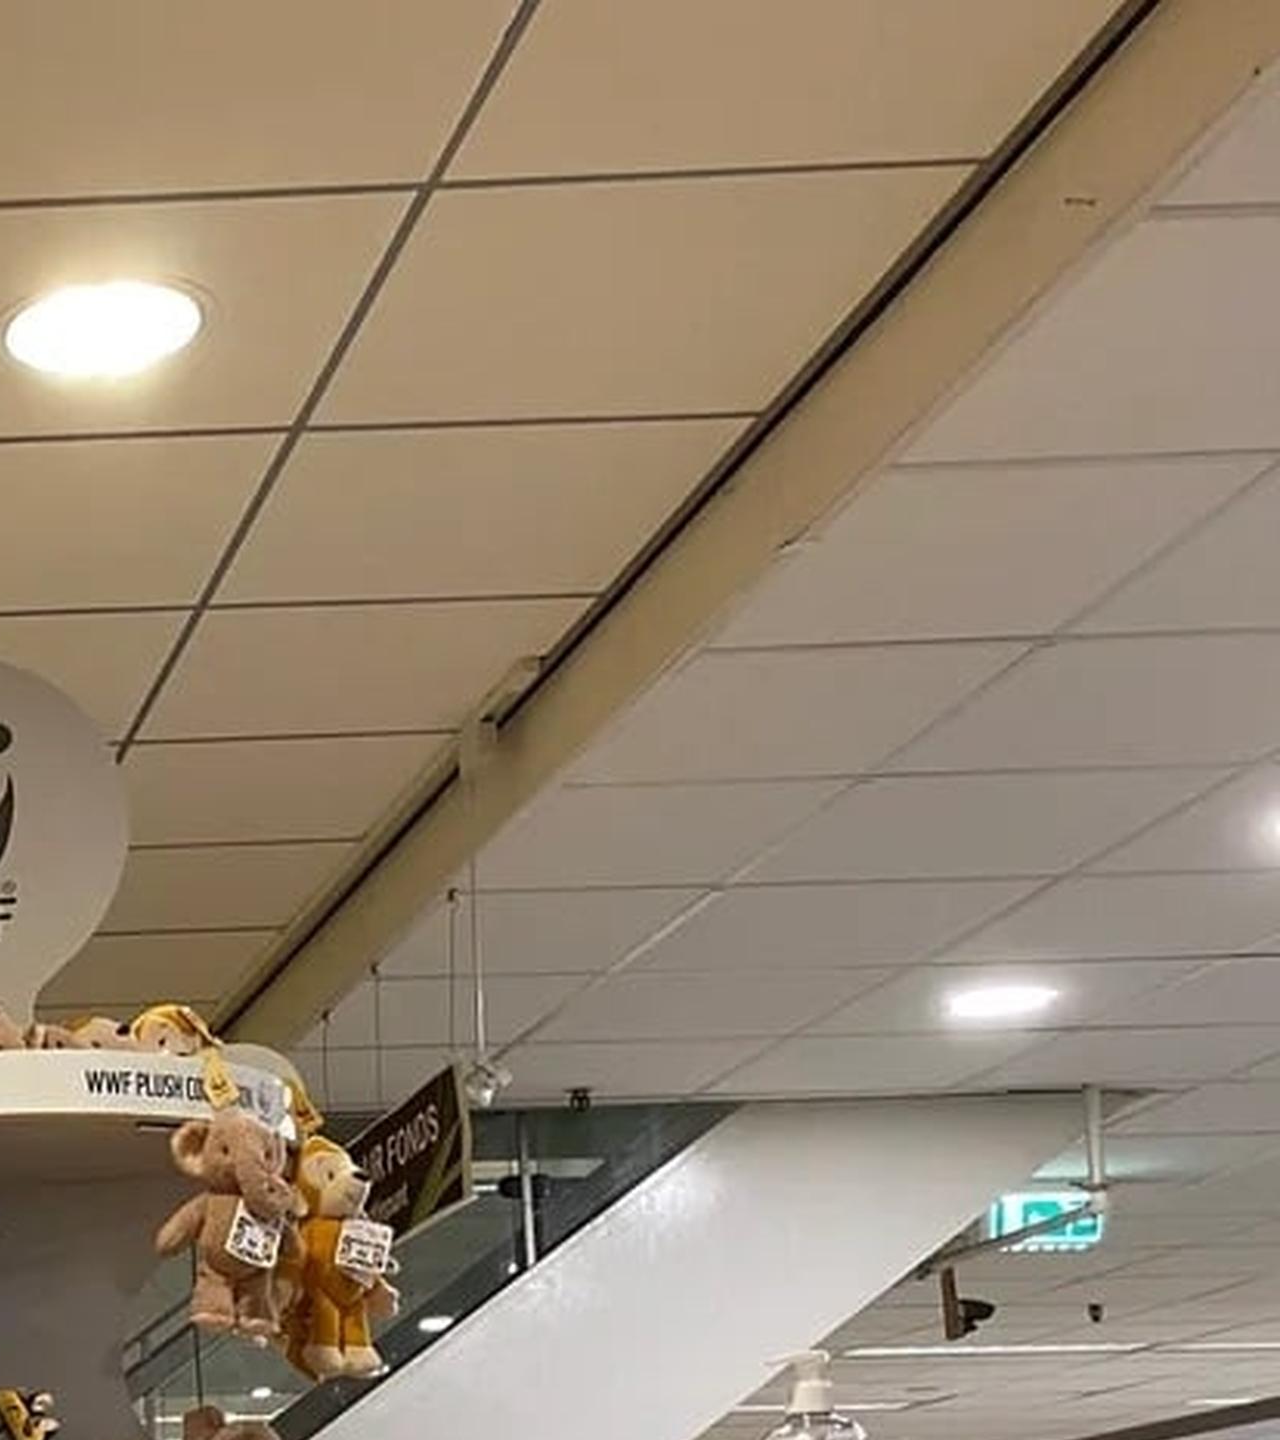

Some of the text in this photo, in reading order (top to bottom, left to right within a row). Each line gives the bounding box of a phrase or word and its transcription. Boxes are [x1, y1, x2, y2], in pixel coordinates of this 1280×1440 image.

[84, 1069, 132, 1095] WWF
[135, 1073, 184, 1098] PLUSH
[385, 1103, 440, 1174] FONDS
